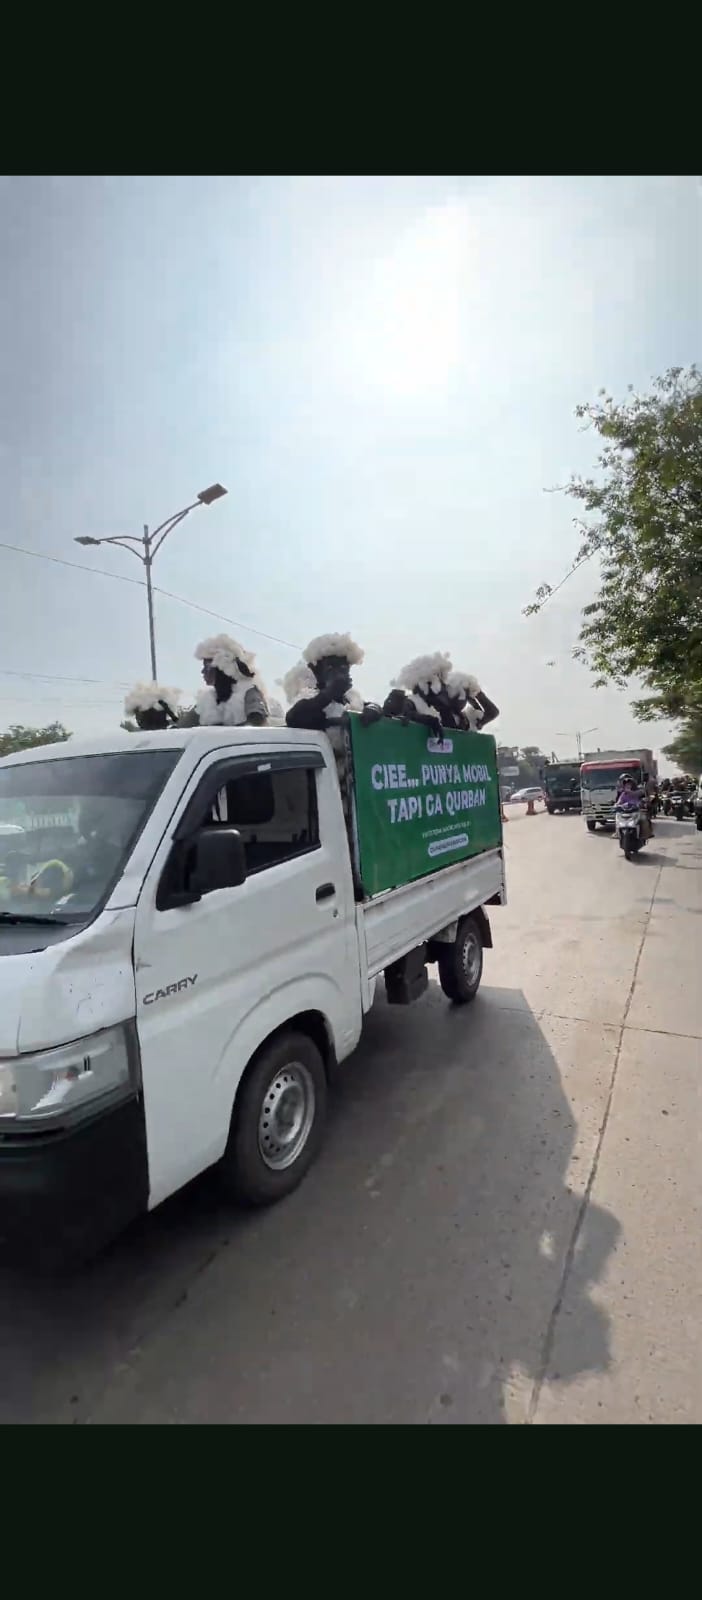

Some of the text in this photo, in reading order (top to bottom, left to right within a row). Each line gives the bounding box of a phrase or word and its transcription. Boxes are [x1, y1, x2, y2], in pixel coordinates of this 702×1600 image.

[371, 764, 492, 790] CIEE... PUNYA MOBIL
[387, 797, 422, 824] TAPI
[445, 788, 486, 815] QURBAN
[142, 974, 198, 1005] CARRY
